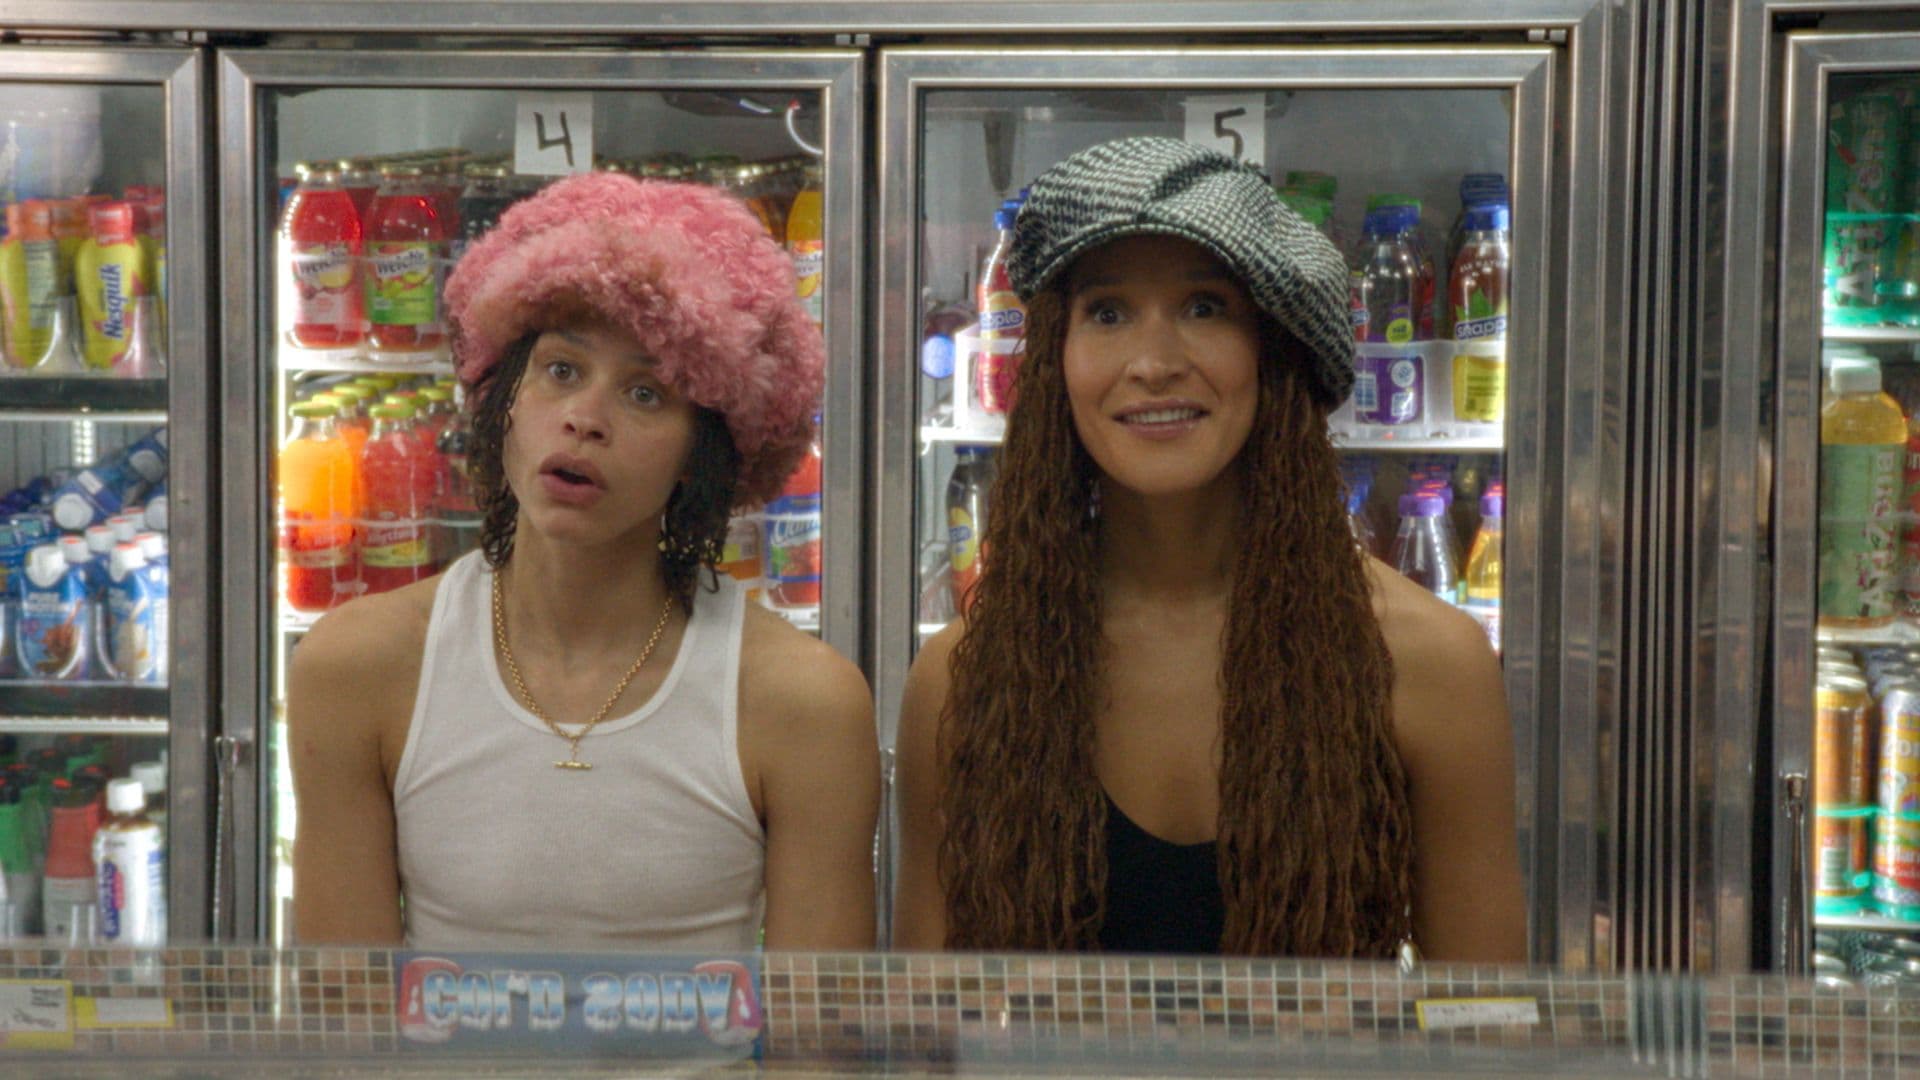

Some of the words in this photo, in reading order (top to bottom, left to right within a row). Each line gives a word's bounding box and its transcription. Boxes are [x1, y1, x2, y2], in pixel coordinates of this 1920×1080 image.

[533, 111, 575, 167] 4
[1214, 107, 1247, 159] 5
[100, 263, 128, 339] Nesquik
